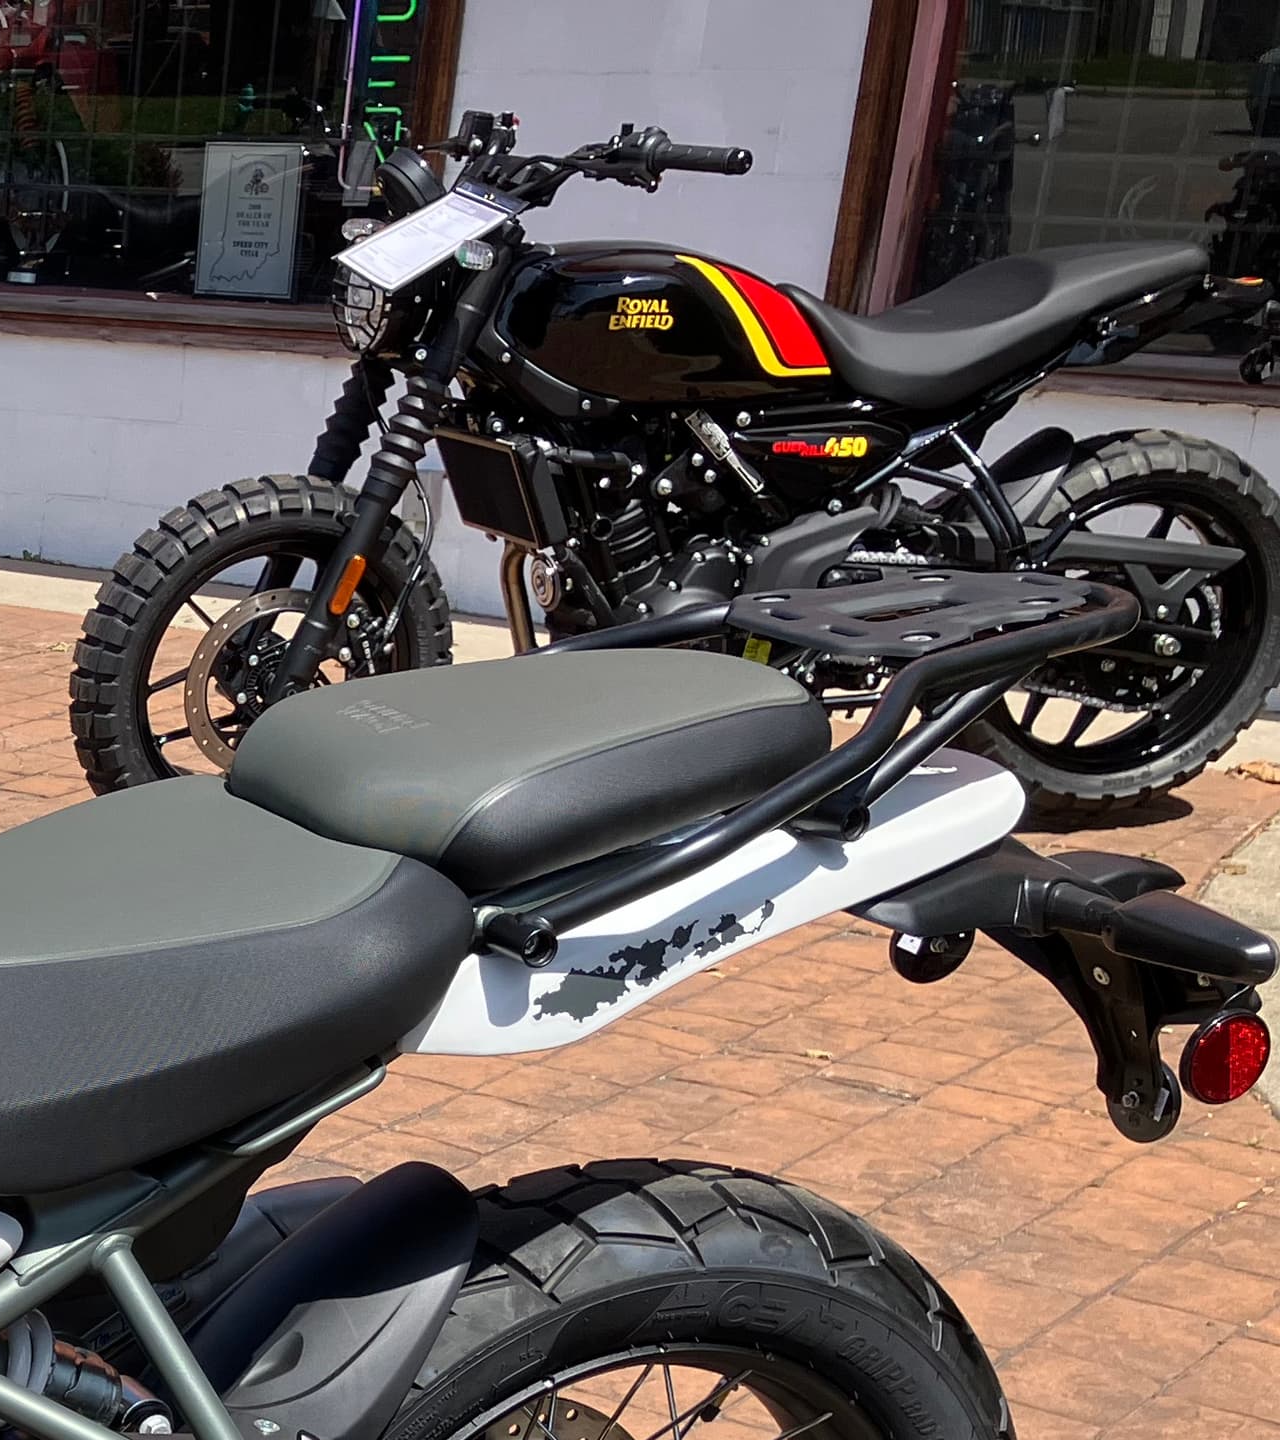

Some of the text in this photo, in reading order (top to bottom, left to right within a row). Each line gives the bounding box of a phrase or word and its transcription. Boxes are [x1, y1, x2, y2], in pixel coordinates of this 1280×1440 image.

[616, 296, 670, 314] ROYAL
[608, 314, 674, 331] ENFIELD
[824, 436, 868, 458] 450
[840, 1334, 916, 1395] GRIPP
